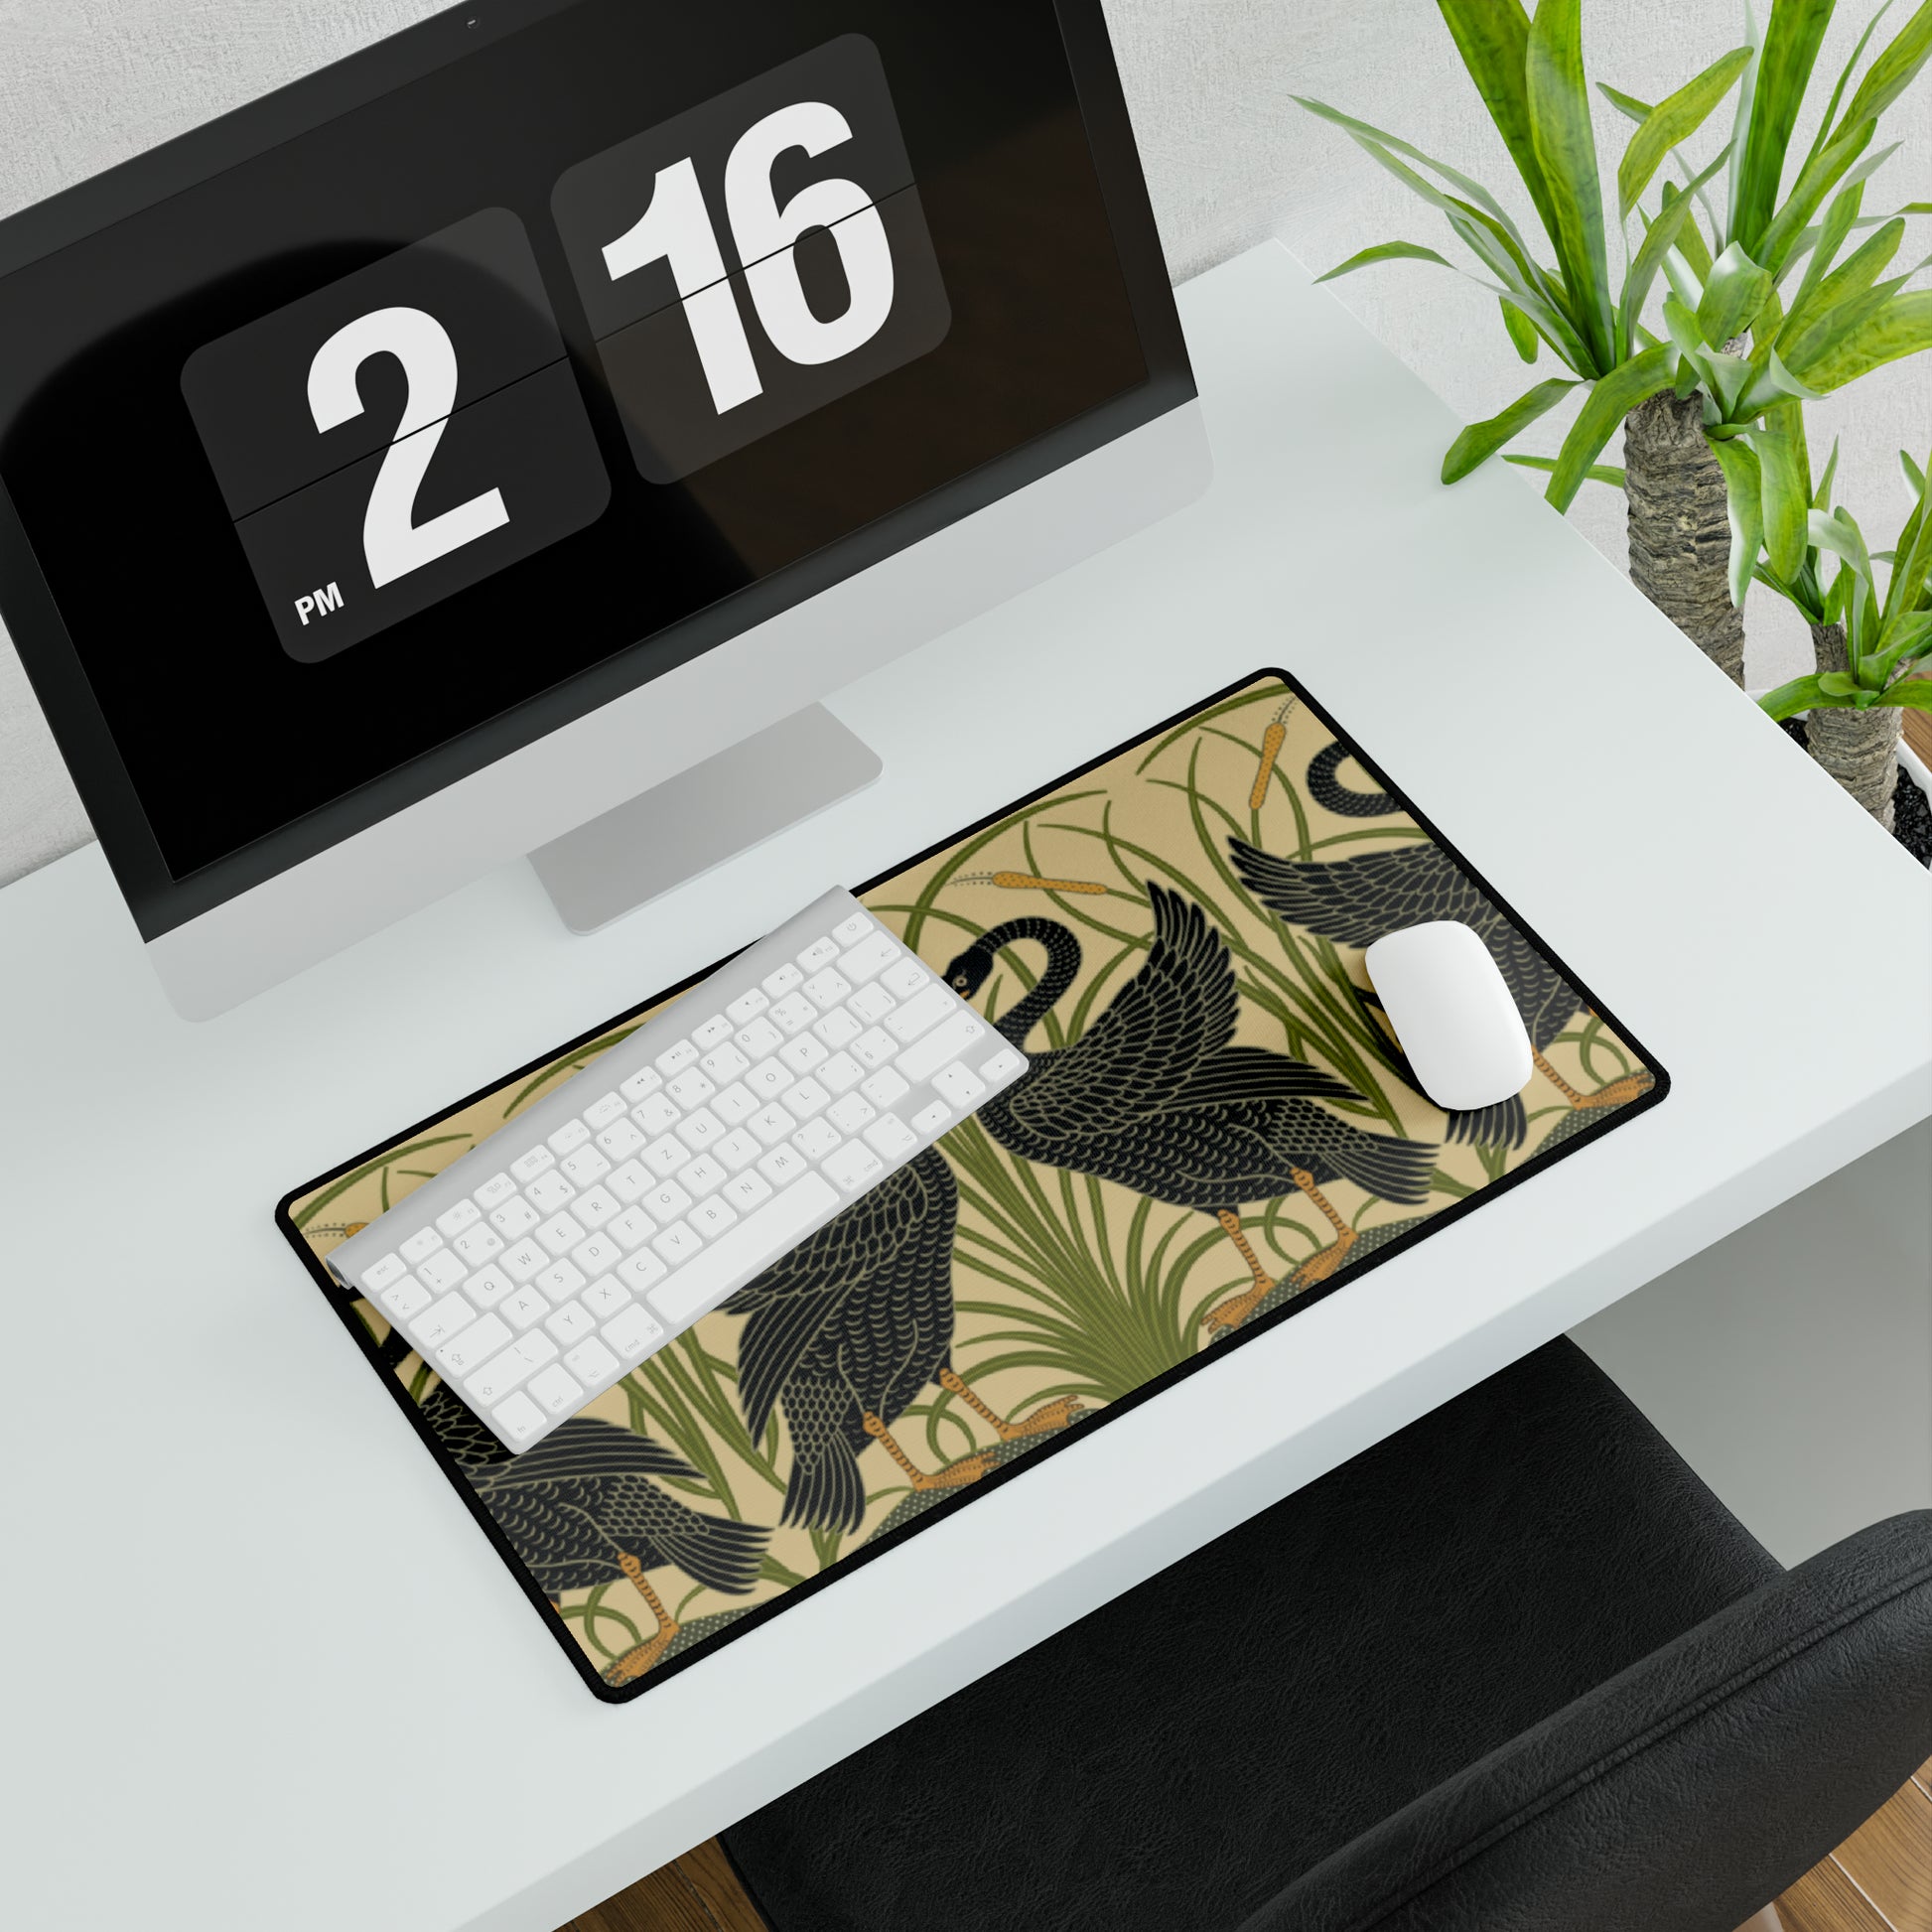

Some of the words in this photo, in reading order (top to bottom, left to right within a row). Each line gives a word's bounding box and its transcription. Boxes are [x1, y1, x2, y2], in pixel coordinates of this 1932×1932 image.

[307, 306, 510, 590] 2
[601, 101, 895, 416] 16
[294, 581, 345, 626] PM
[798, 1047, 808, 1057] P
[706, 1058, 716, 1068] 9
[671, 1084, 682, 1094] 8
[798, 1090, 810, 1101] L
[635, 1109, 645, 1120] 7
[763, 1115, 776, 1127] K
[695, 1123, 708, 1135] U
[603, 1136, 612, 1145] 6
[731, 1141, 740, 1152] J
[660, 1149, 673, 1161] Z
[567, 1161, 577, 1172] 5
[774, 1156, 789, 1169] M
[863, 1157, 880, 1173] cmd
[693, 1167, 707, 1178] H
[625, 1174, 636, 1184] T
[533, 1186, 542, 1195] 4
[740, 1181, 754, 1194] N
[659, 1192, 671, 1204] G
[591, 1201, 603, 1212] R
[495, 1213, 506, 1223] 3
[705, 1209, 718, 1220] B
[624, 1219, 635, 1230] F
[555, 1227, 567, 1238] E
[460, 1239, 471, 1250] 2
[669, 1234, 681, 1245] V
[588, 1246, 602, 1258] D
[517, 1252, 532, 1266] W
[635, 1261, 647, 1272] C
[553, 1273, 564, 1284] S
[483, 1281, 495, 1292] Q
[599, 1288, 613, 1301] X
[517, 1300, 530, 1311] A
[562, 1313, 574, 1325] Y
[623, 1338, 640, 1353] cmd
